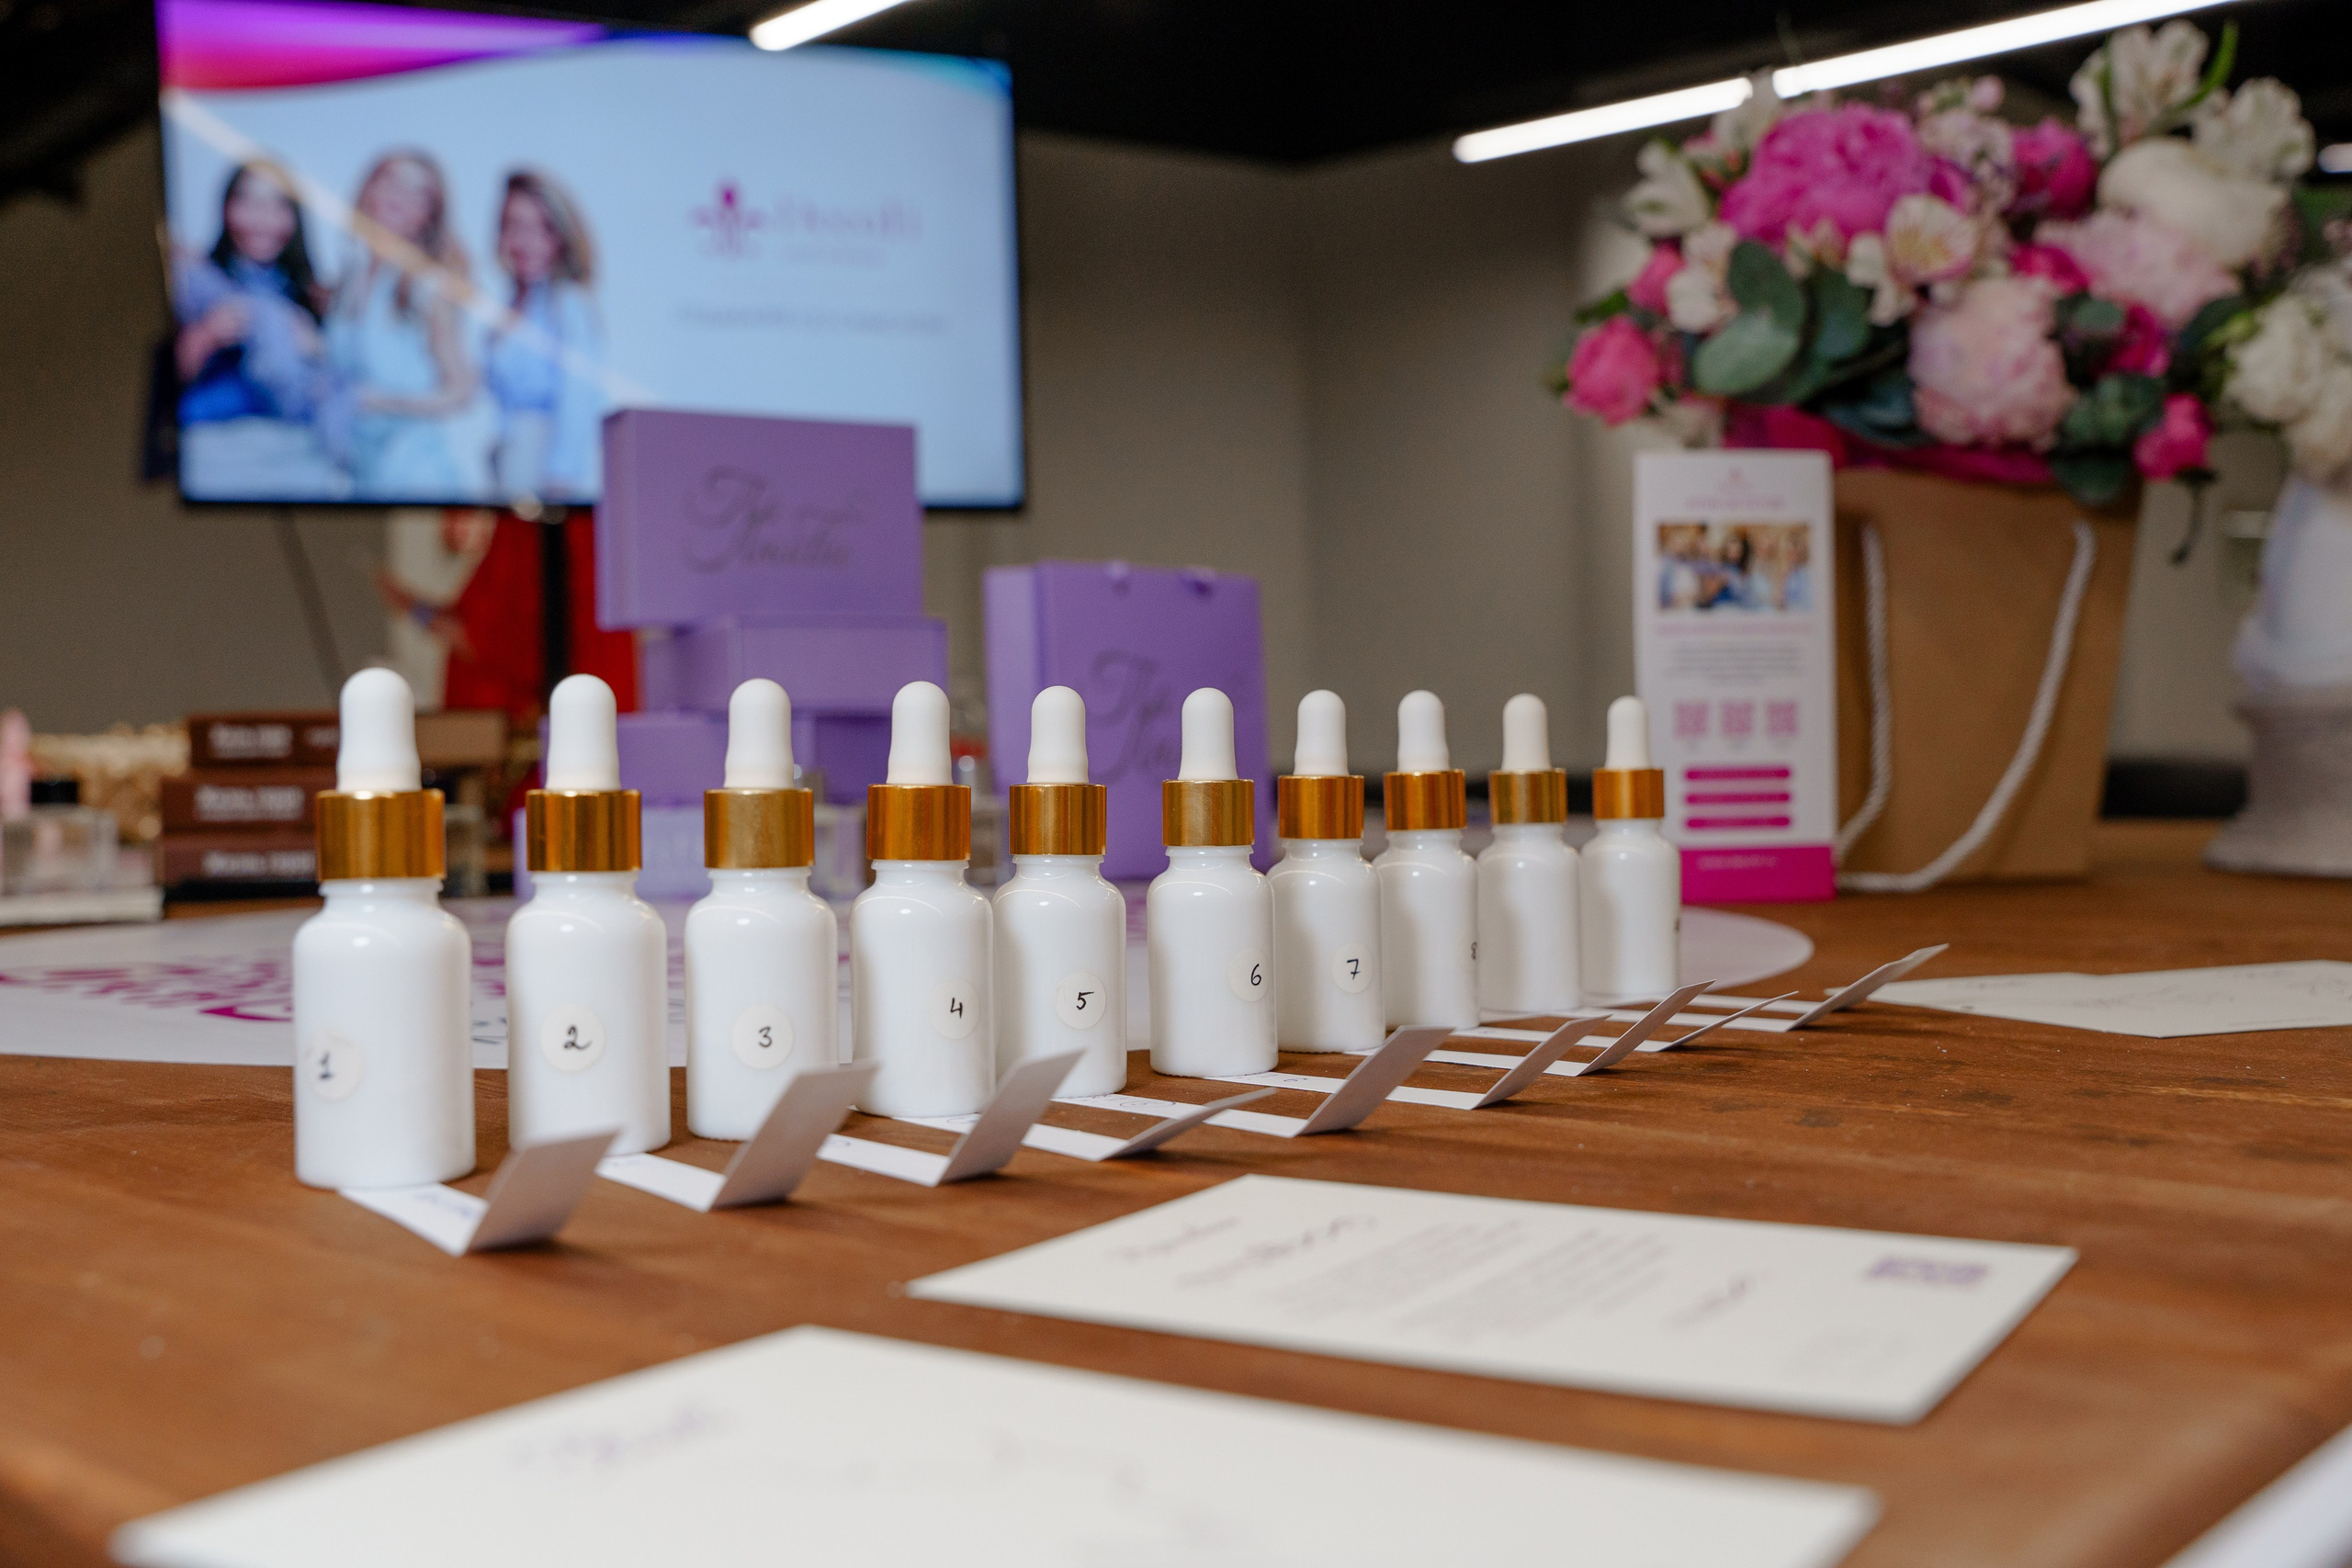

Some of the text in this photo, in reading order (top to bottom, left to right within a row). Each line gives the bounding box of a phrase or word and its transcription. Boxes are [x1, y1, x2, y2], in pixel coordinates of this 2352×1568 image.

[1250, 963, 1263, 987] 6
[1346, 958, 1362, 981] 7
[949, 997, 965, 1020] 4
[1075, 990, 1095, 1011] 5
[562, 1024, 593, 1052] 2
[757, 1025, 774, 1049] 3
[318, 1050, 334, 1081] 1
